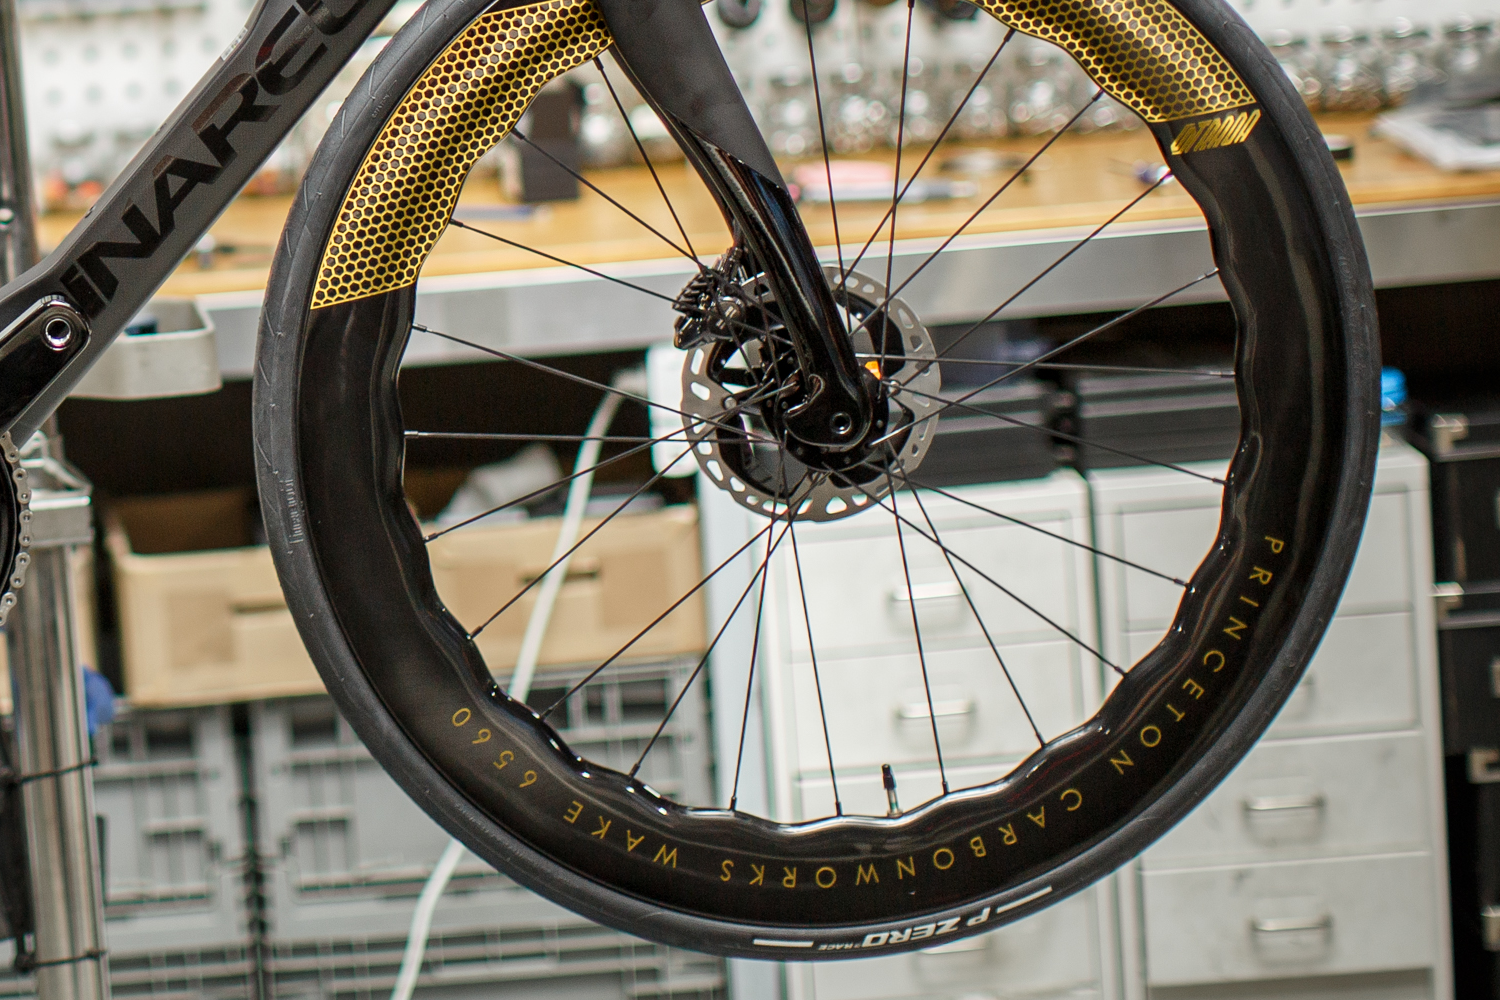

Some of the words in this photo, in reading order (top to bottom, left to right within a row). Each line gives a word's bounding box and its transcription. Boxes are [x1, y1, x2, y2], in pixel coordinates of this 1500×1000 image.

[1110, 535, 1285, 775] PRINCETON
[450, 708, 539, 789] 6560
[562, 799, 678, 869] WAKE
[719, 788, 1083, 889] CARBONWORKS
[862, 917, 961, 948] ZERO
[966, 906, 991, 927] P
